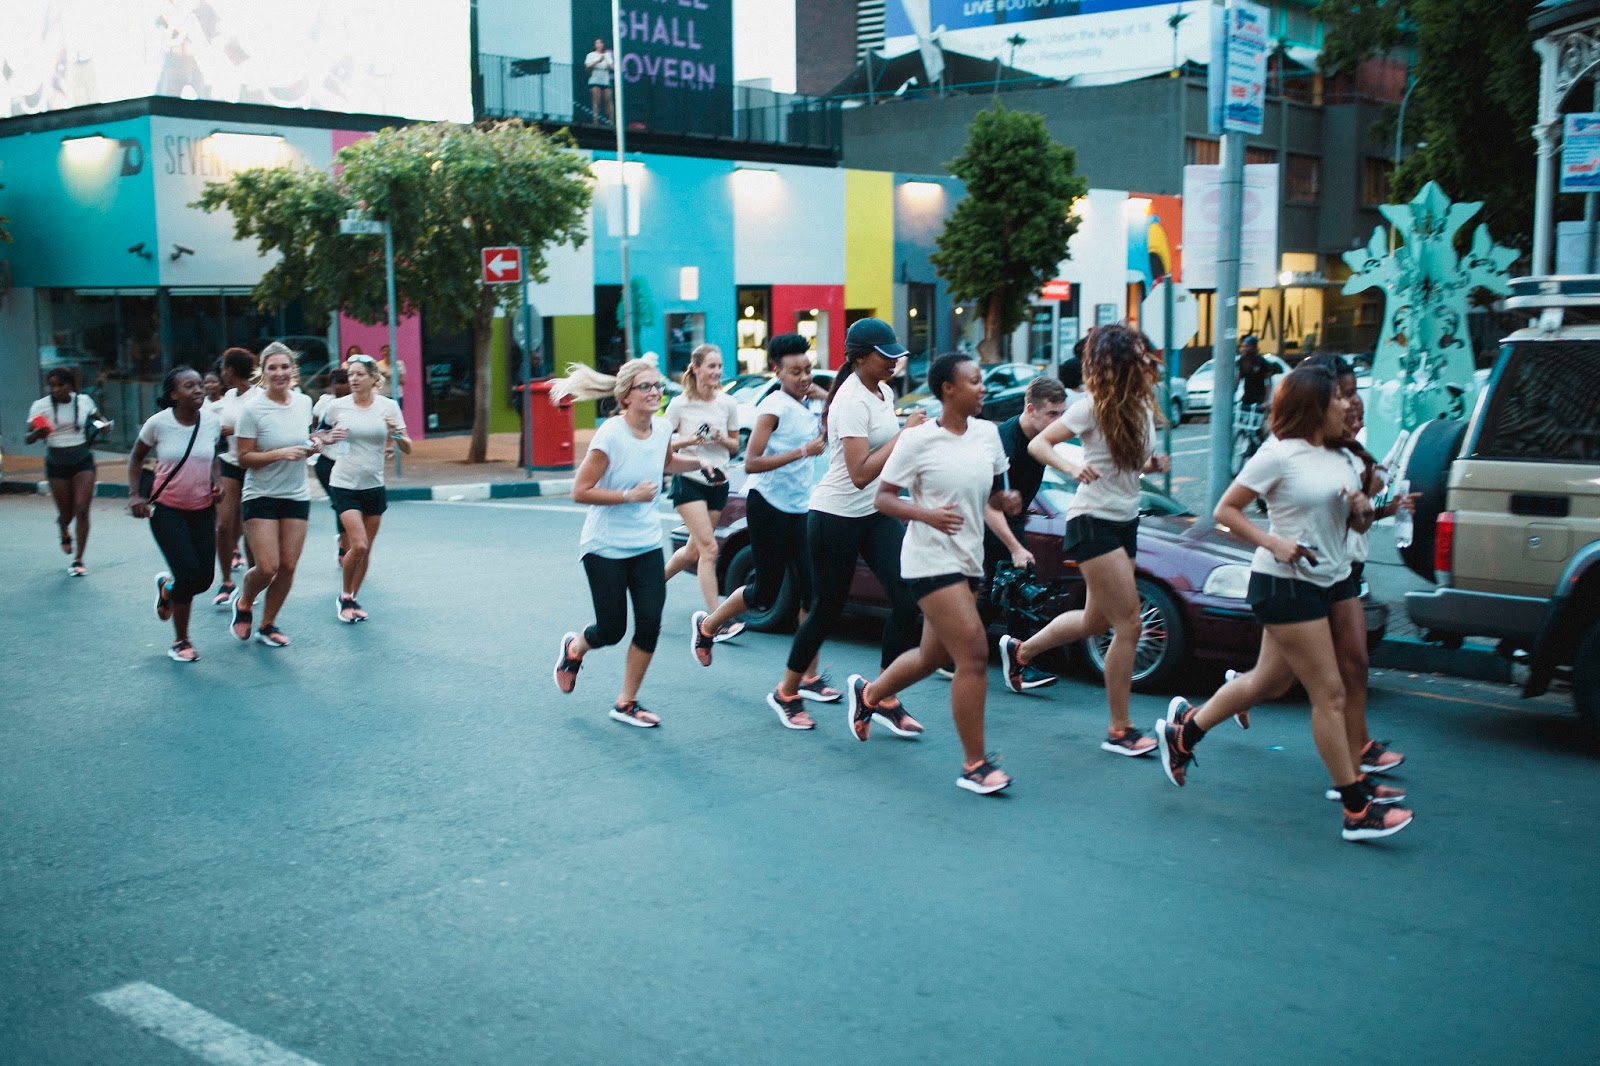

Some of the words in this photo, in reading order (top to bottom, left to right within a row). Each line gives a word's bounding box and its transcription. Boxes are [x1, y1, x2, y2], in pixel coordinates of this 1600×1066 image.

[963, 1, 994, 16] LIVE
[619, 9, 703, 49] SHALL
[607, 49, 716, 91] OVERN
